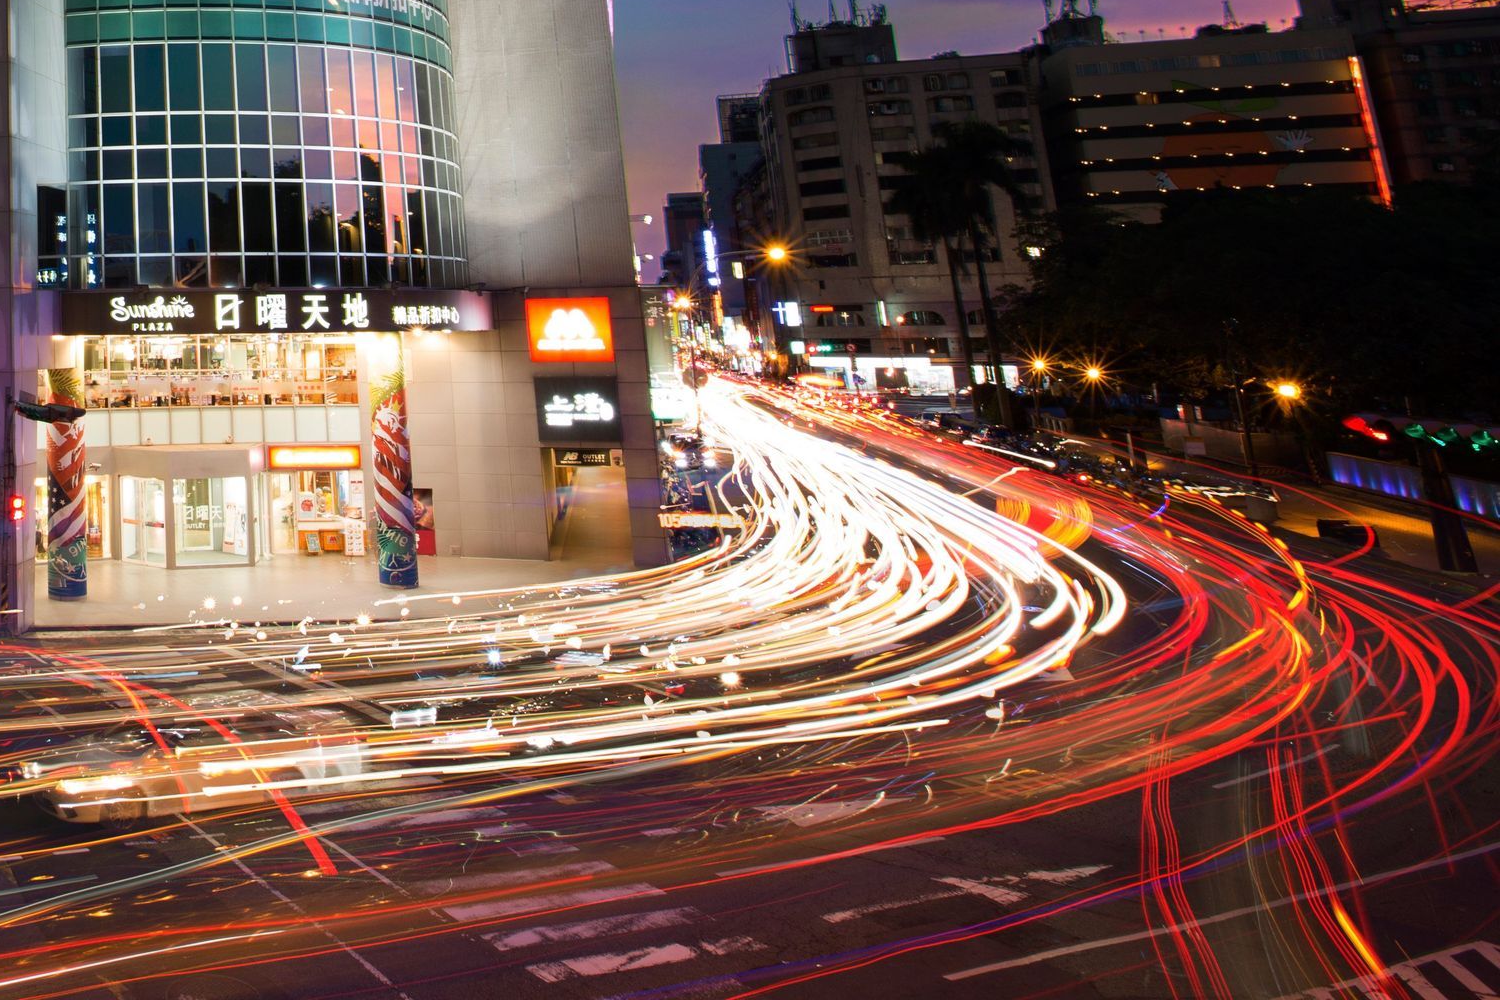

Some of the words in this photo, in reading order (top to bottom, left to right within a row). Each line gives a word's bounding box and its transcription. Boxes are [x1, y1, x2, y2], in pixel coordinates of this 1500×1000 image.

[110, 295, 195, 322] Sunshine
[214, 293, 370, 330] 日曜天地
[132, 322, 174, 331] PLAZA
